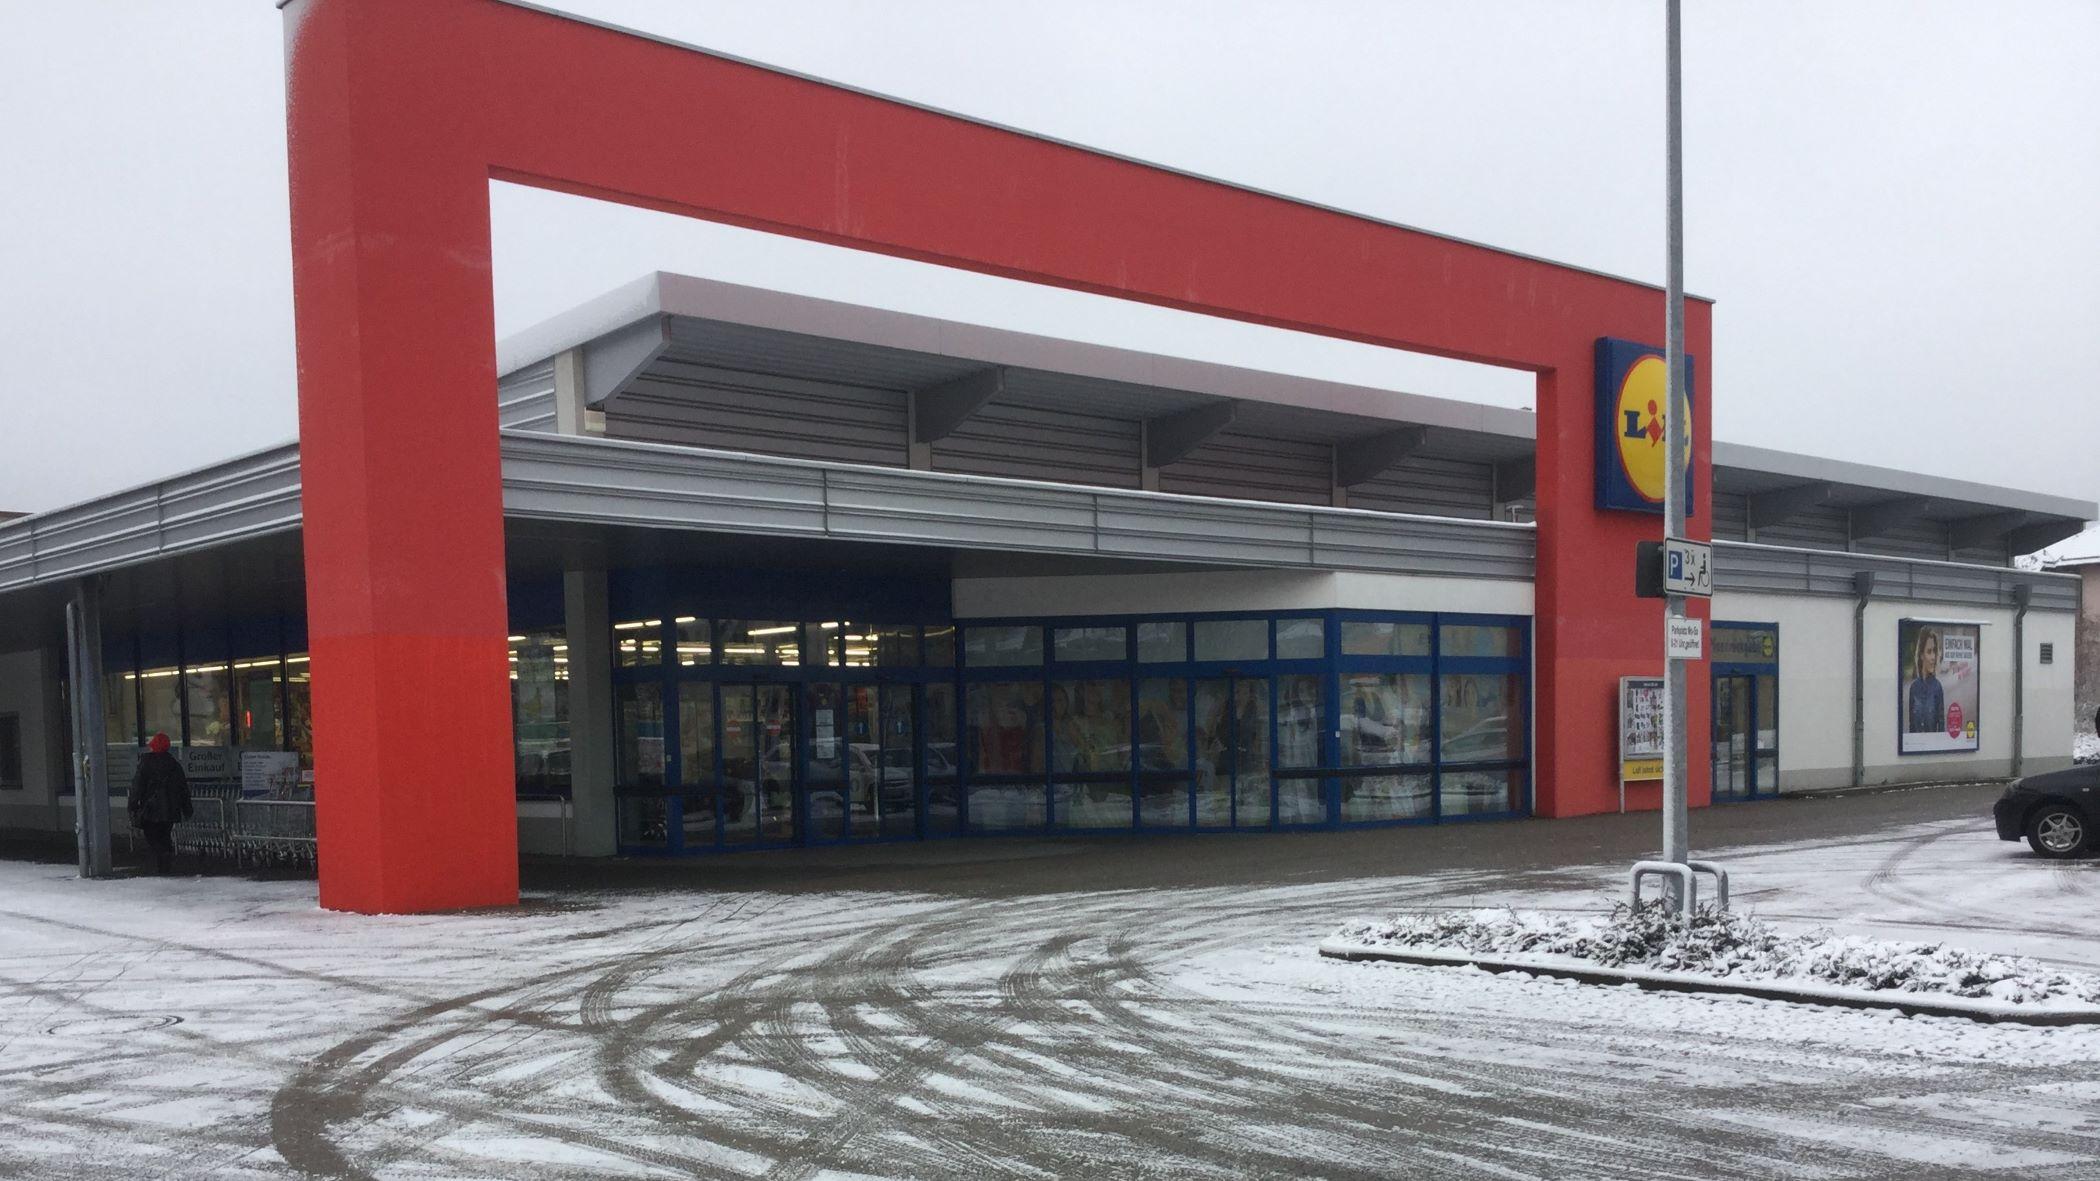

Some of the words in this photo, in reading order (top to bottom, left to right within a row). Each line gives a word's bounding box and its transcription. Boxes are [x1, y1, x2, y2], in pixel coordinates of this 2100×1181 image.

[1684, 548, 1695, 566] 3x
[1670, 553, 1679, 576] P
[189, 751, 222, 760] Großer
[188, 763, 225, 772] Einkauf
